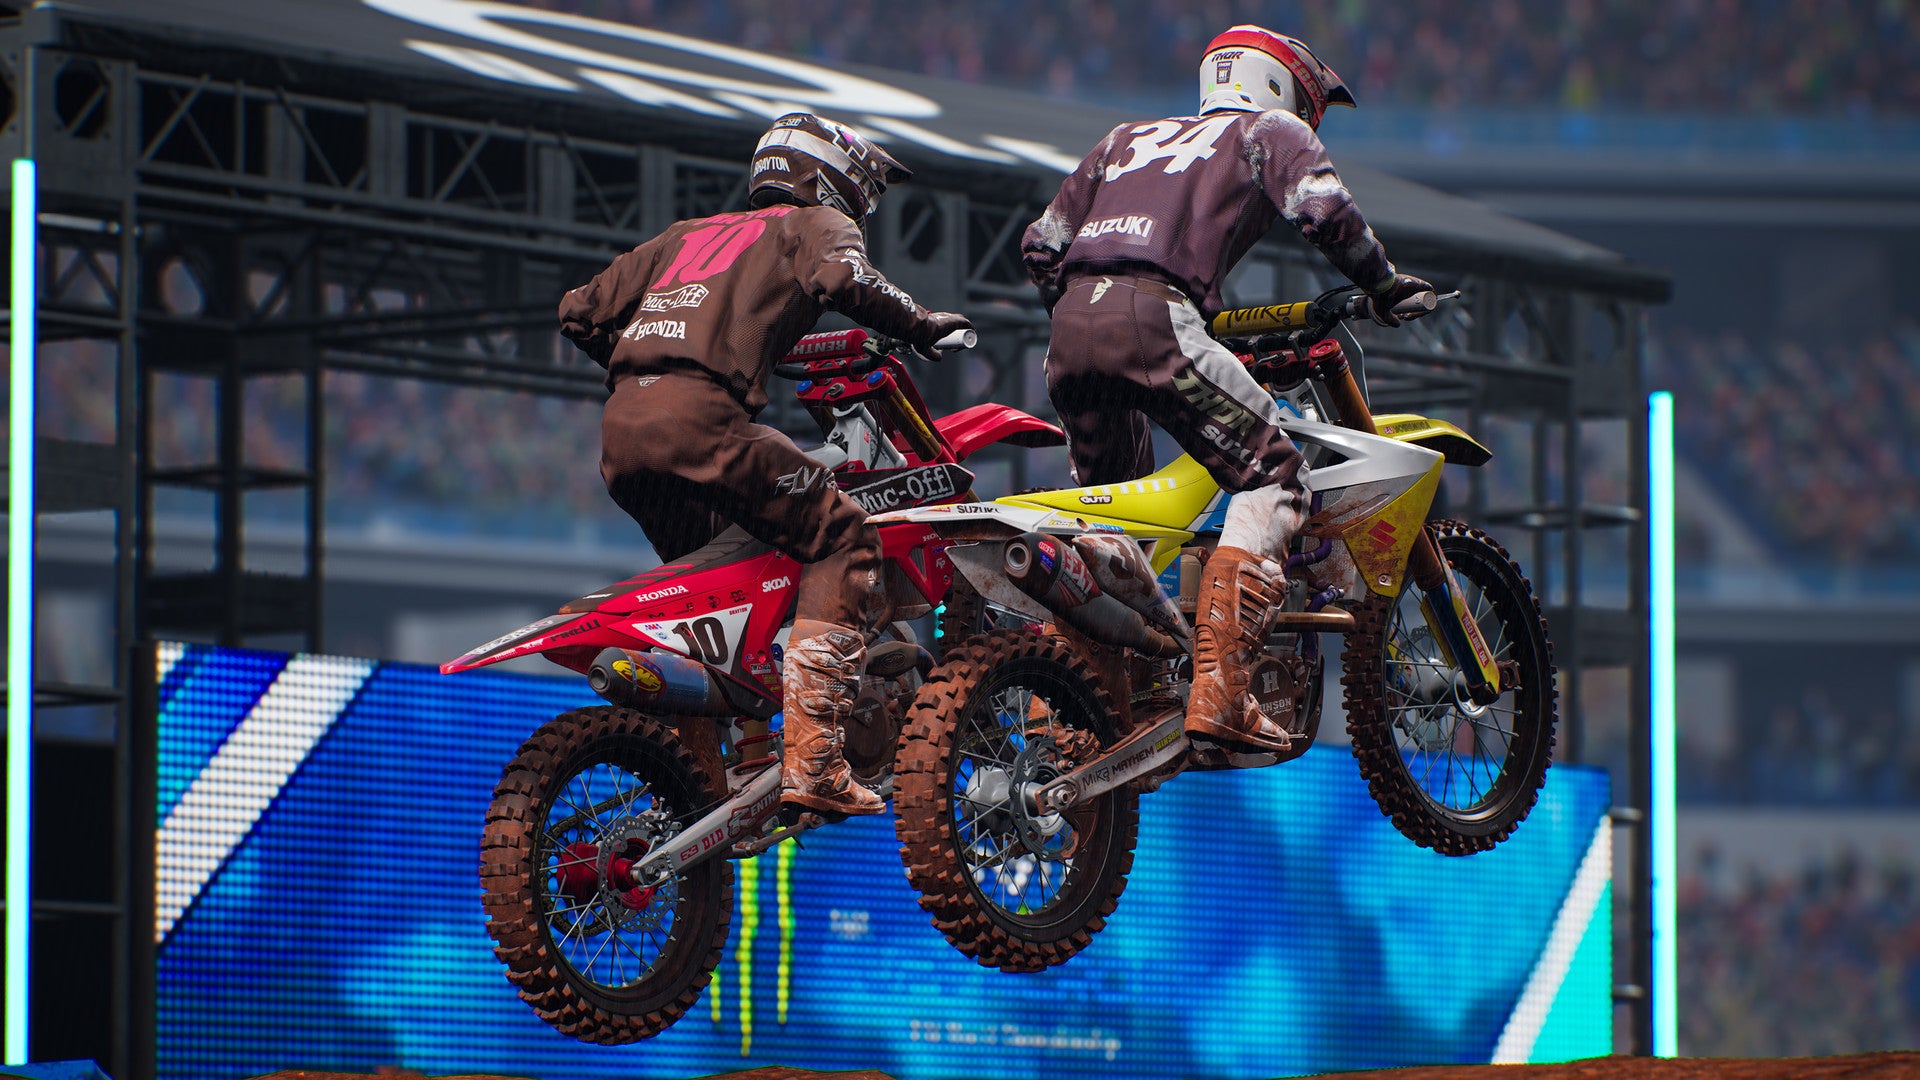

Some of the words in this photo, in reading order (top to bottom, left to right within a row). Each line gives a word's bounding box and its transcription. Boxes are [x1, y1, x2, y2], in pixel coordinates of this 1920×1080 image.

[1105, 114, 1241, 182] 34
[1078, 215, 1153, 238] SUZUKI
[650, 218, 767, 290] 10
[634, 319, 686, 341] HONDA
[636, 584, 689, 603] HONDA
[671, 616, 729, 666] 10
[1111, 745, 1155, 775] MAYHEM
